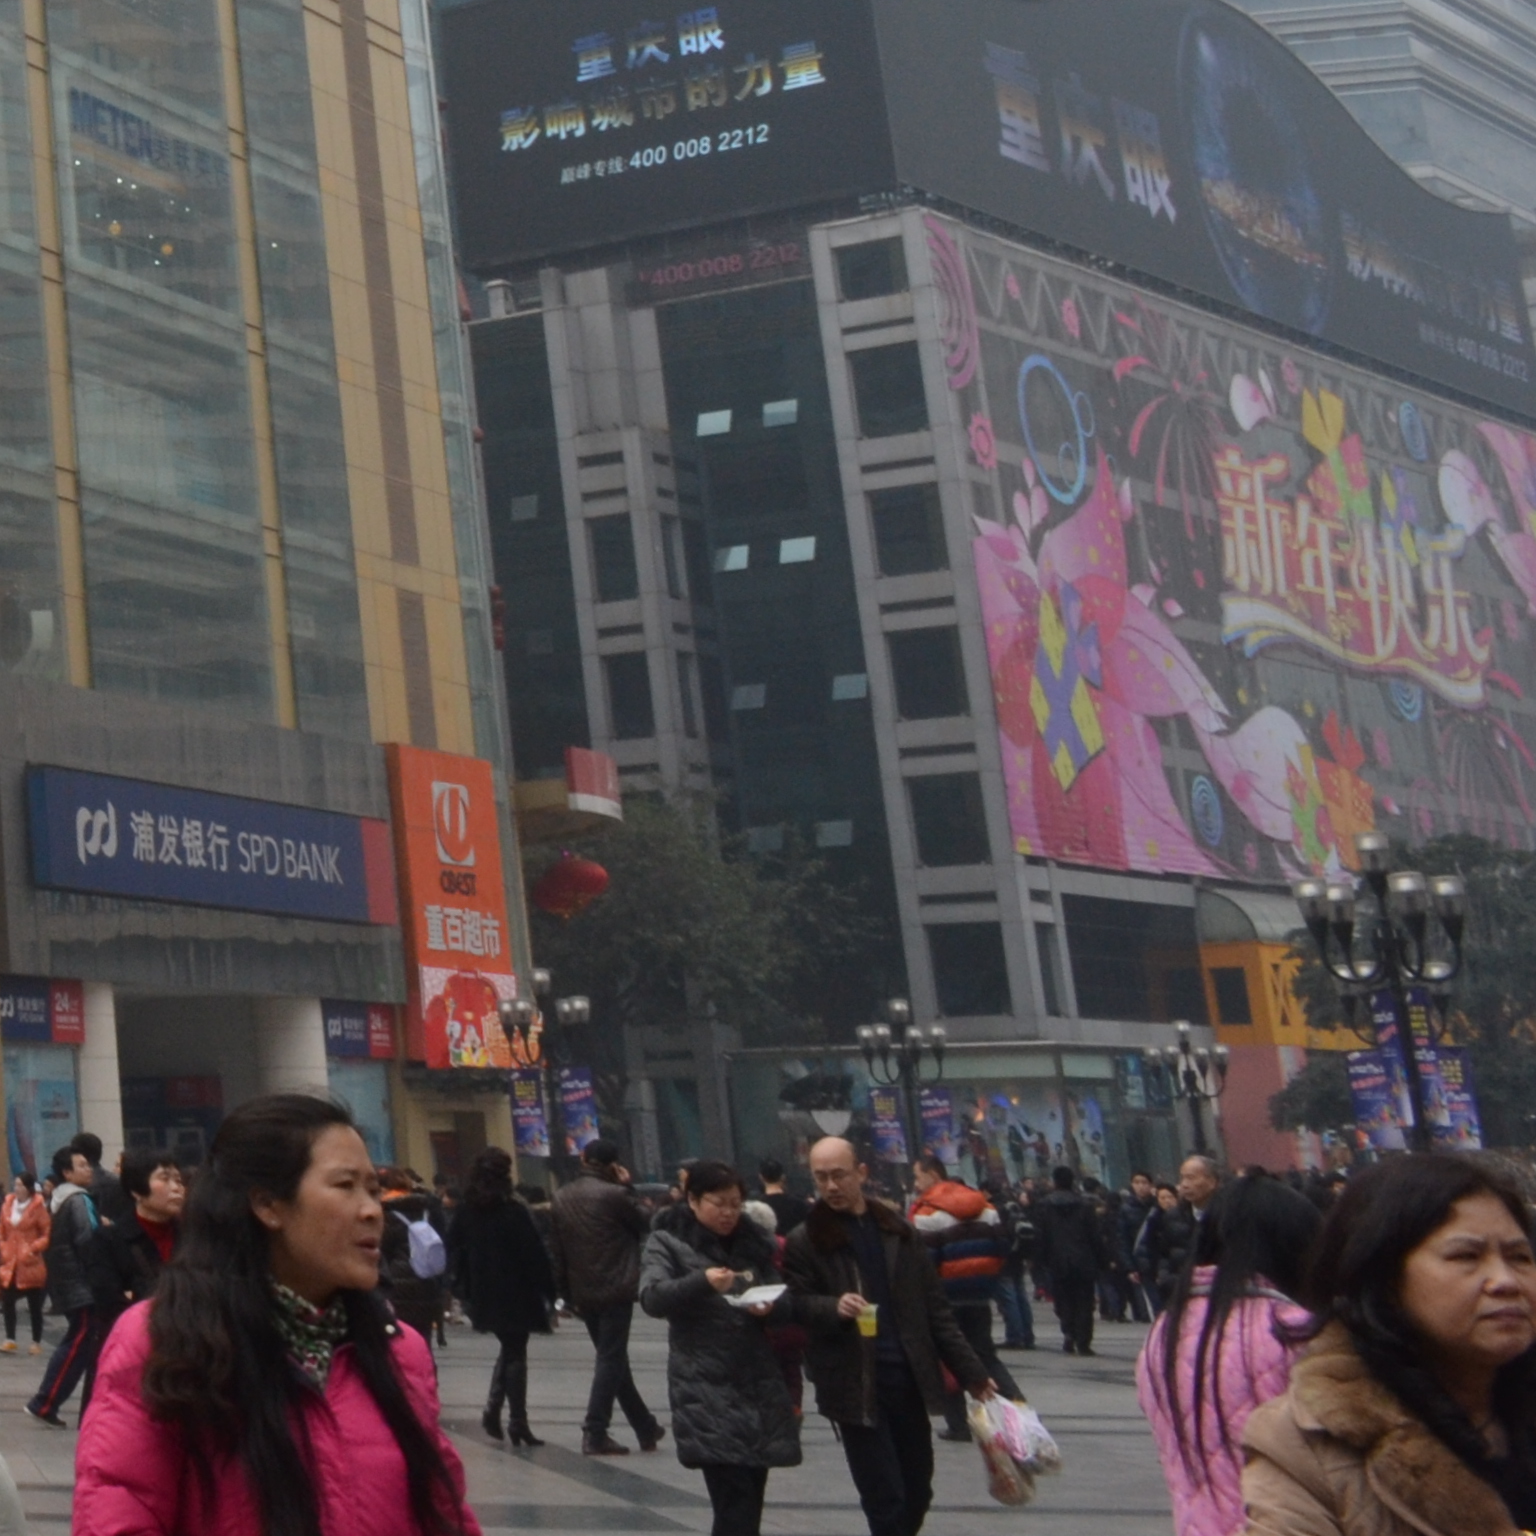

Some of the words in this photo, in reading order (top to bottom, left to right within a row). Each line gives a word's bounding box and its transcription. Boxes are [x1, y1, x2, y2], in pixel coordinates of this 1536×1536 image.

[571, 7, 725, 82] 重庆眼
[499, 40, 826, 152] 影响城市的力量
[984, 40, 1177, 225] 重庆眼
[629, 146, 667, 169] 400
[673, 135, 711, 160] 008
[717, 123, 770, 152] 2212
[131, 810, 230, 872] 浦发银行
[237, 831, 278, 876] SPD
[282, 837, 344, 885] BANK
[424, 904, 501, 959] 重百超市
